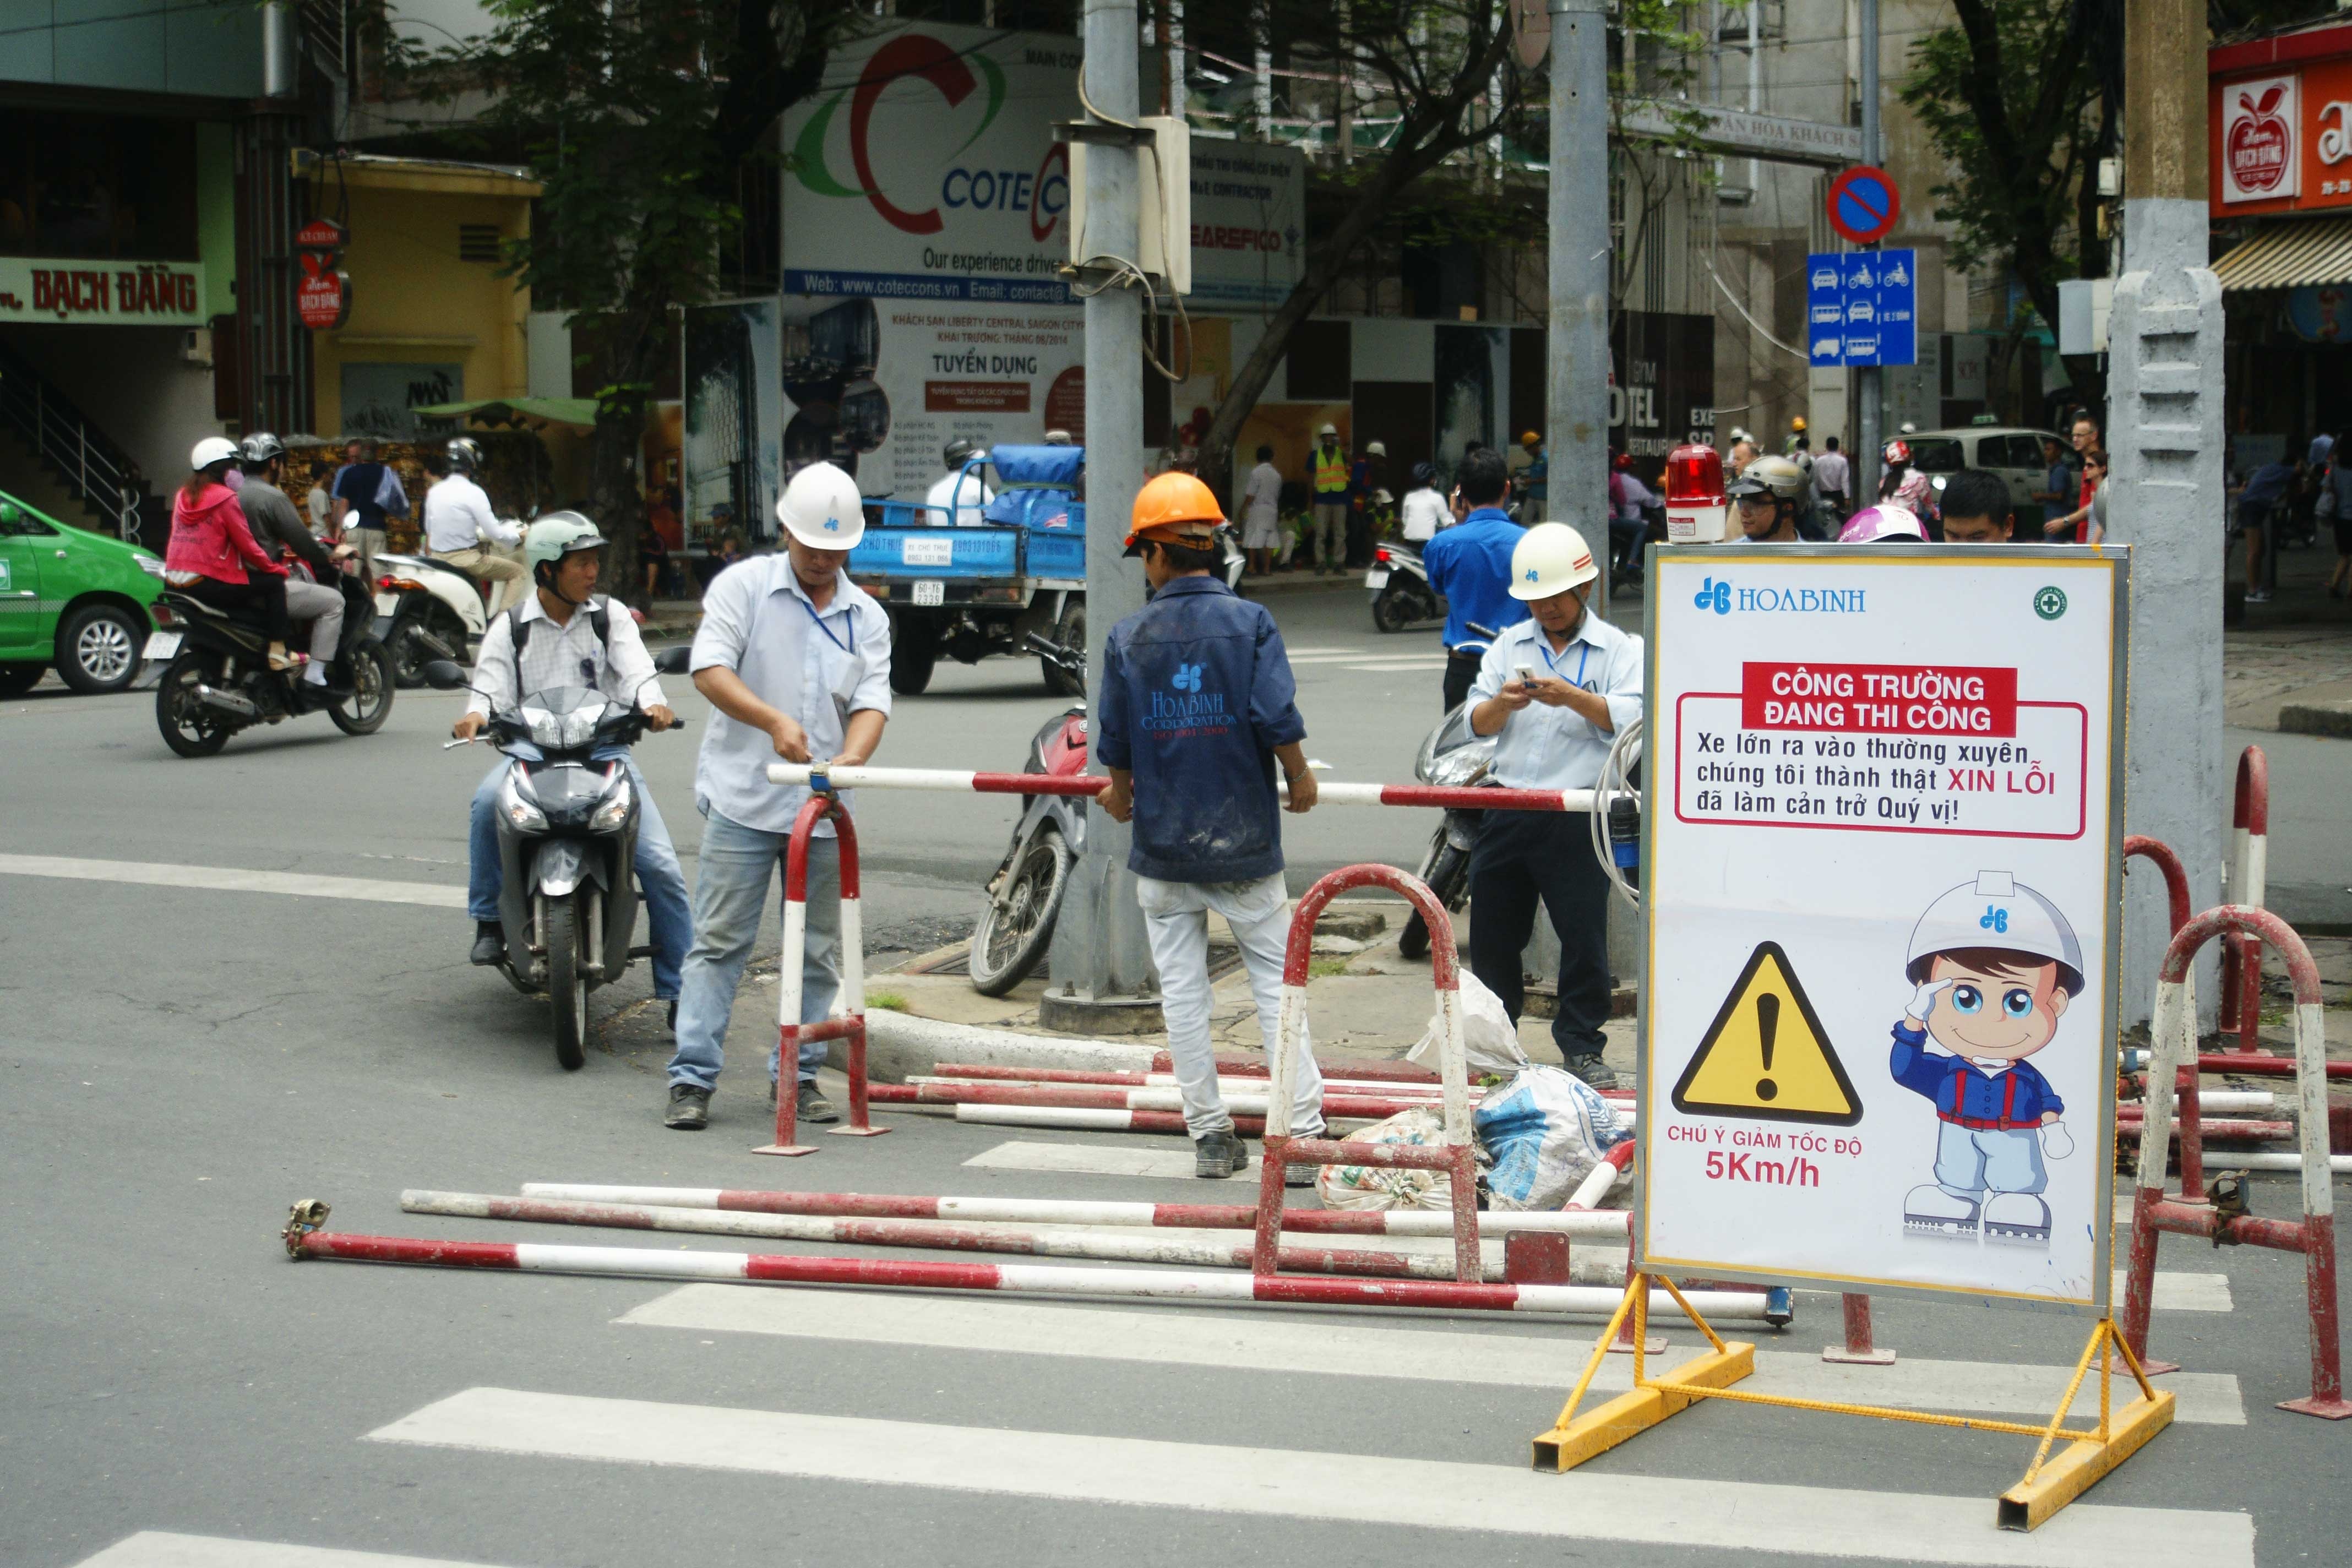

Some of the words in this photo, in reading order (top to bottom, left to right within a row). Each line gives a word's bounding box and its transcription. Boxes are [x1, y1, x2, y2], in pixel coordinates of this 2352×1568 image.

[924, 246, 949, 269] Our
[951, 251, 1023, 276] experience
[31, 269, 110, 318] BẠCH
[804, 275, 839, 292] Web:
[842, 277, 960, 298] www.coteccons.vn
[948, 317, 984, 328] LIBERTY
[986, 318, 1026, 329] CENTRAL
[933, 346, 987, 374] TUYỂN
[991, 356, 1038, 379] DỤNG
[917, 594, 940, 605] 2339
[1772, 667, 1854, 698] CÔNG
[1861, 670, 1985, 701] TRƯỜNG
[1764, 702, 1844, 727] ĐANG
[1853, 704, 1898, 728] THI
[1906, 701, 1991, 731] CÔNG
[1697, 732, 1725, 754] Xe
[1736, 732, 1771, 755] lớn
[1782, 739, 1804, 756] ra
[1815, 735, 1855, 759] vào
[1867, 736, 1947, 764] thường
[1958, 741, 2028, 767] xuyên
[1697, 762, 1765, 787] chúng
[1775, 764, 1805, 786] tôi
[1815, 764, 1881, 788] thành
[1891, 767, 1937, 794] thật
[1947, 768, 1995, 793] XIN
[2007, 759, 2056, 795] LỖI
[1697, 791, 1722, 811] đã
[1734, 791, 1775, 813] làm
[1785, 791, 1823, 815] cản
[1836, 793, 1868, 817] trở
[1877, 796, 1920, 824] Quý
[1931, 799, 1958, 824] vị!
[1668, 1124, 1707, 1143] CHÚ
[1713, 1125, 1726, 1144] Ý
[1733, 1126, 1781, 1148] GIẢM
[1788, 1130, 1828, 1152] TỐC
[1834, 1136, 1863, 1158] ĐỘ
[1705, 1151, 1819, 1188] 5Km/h
